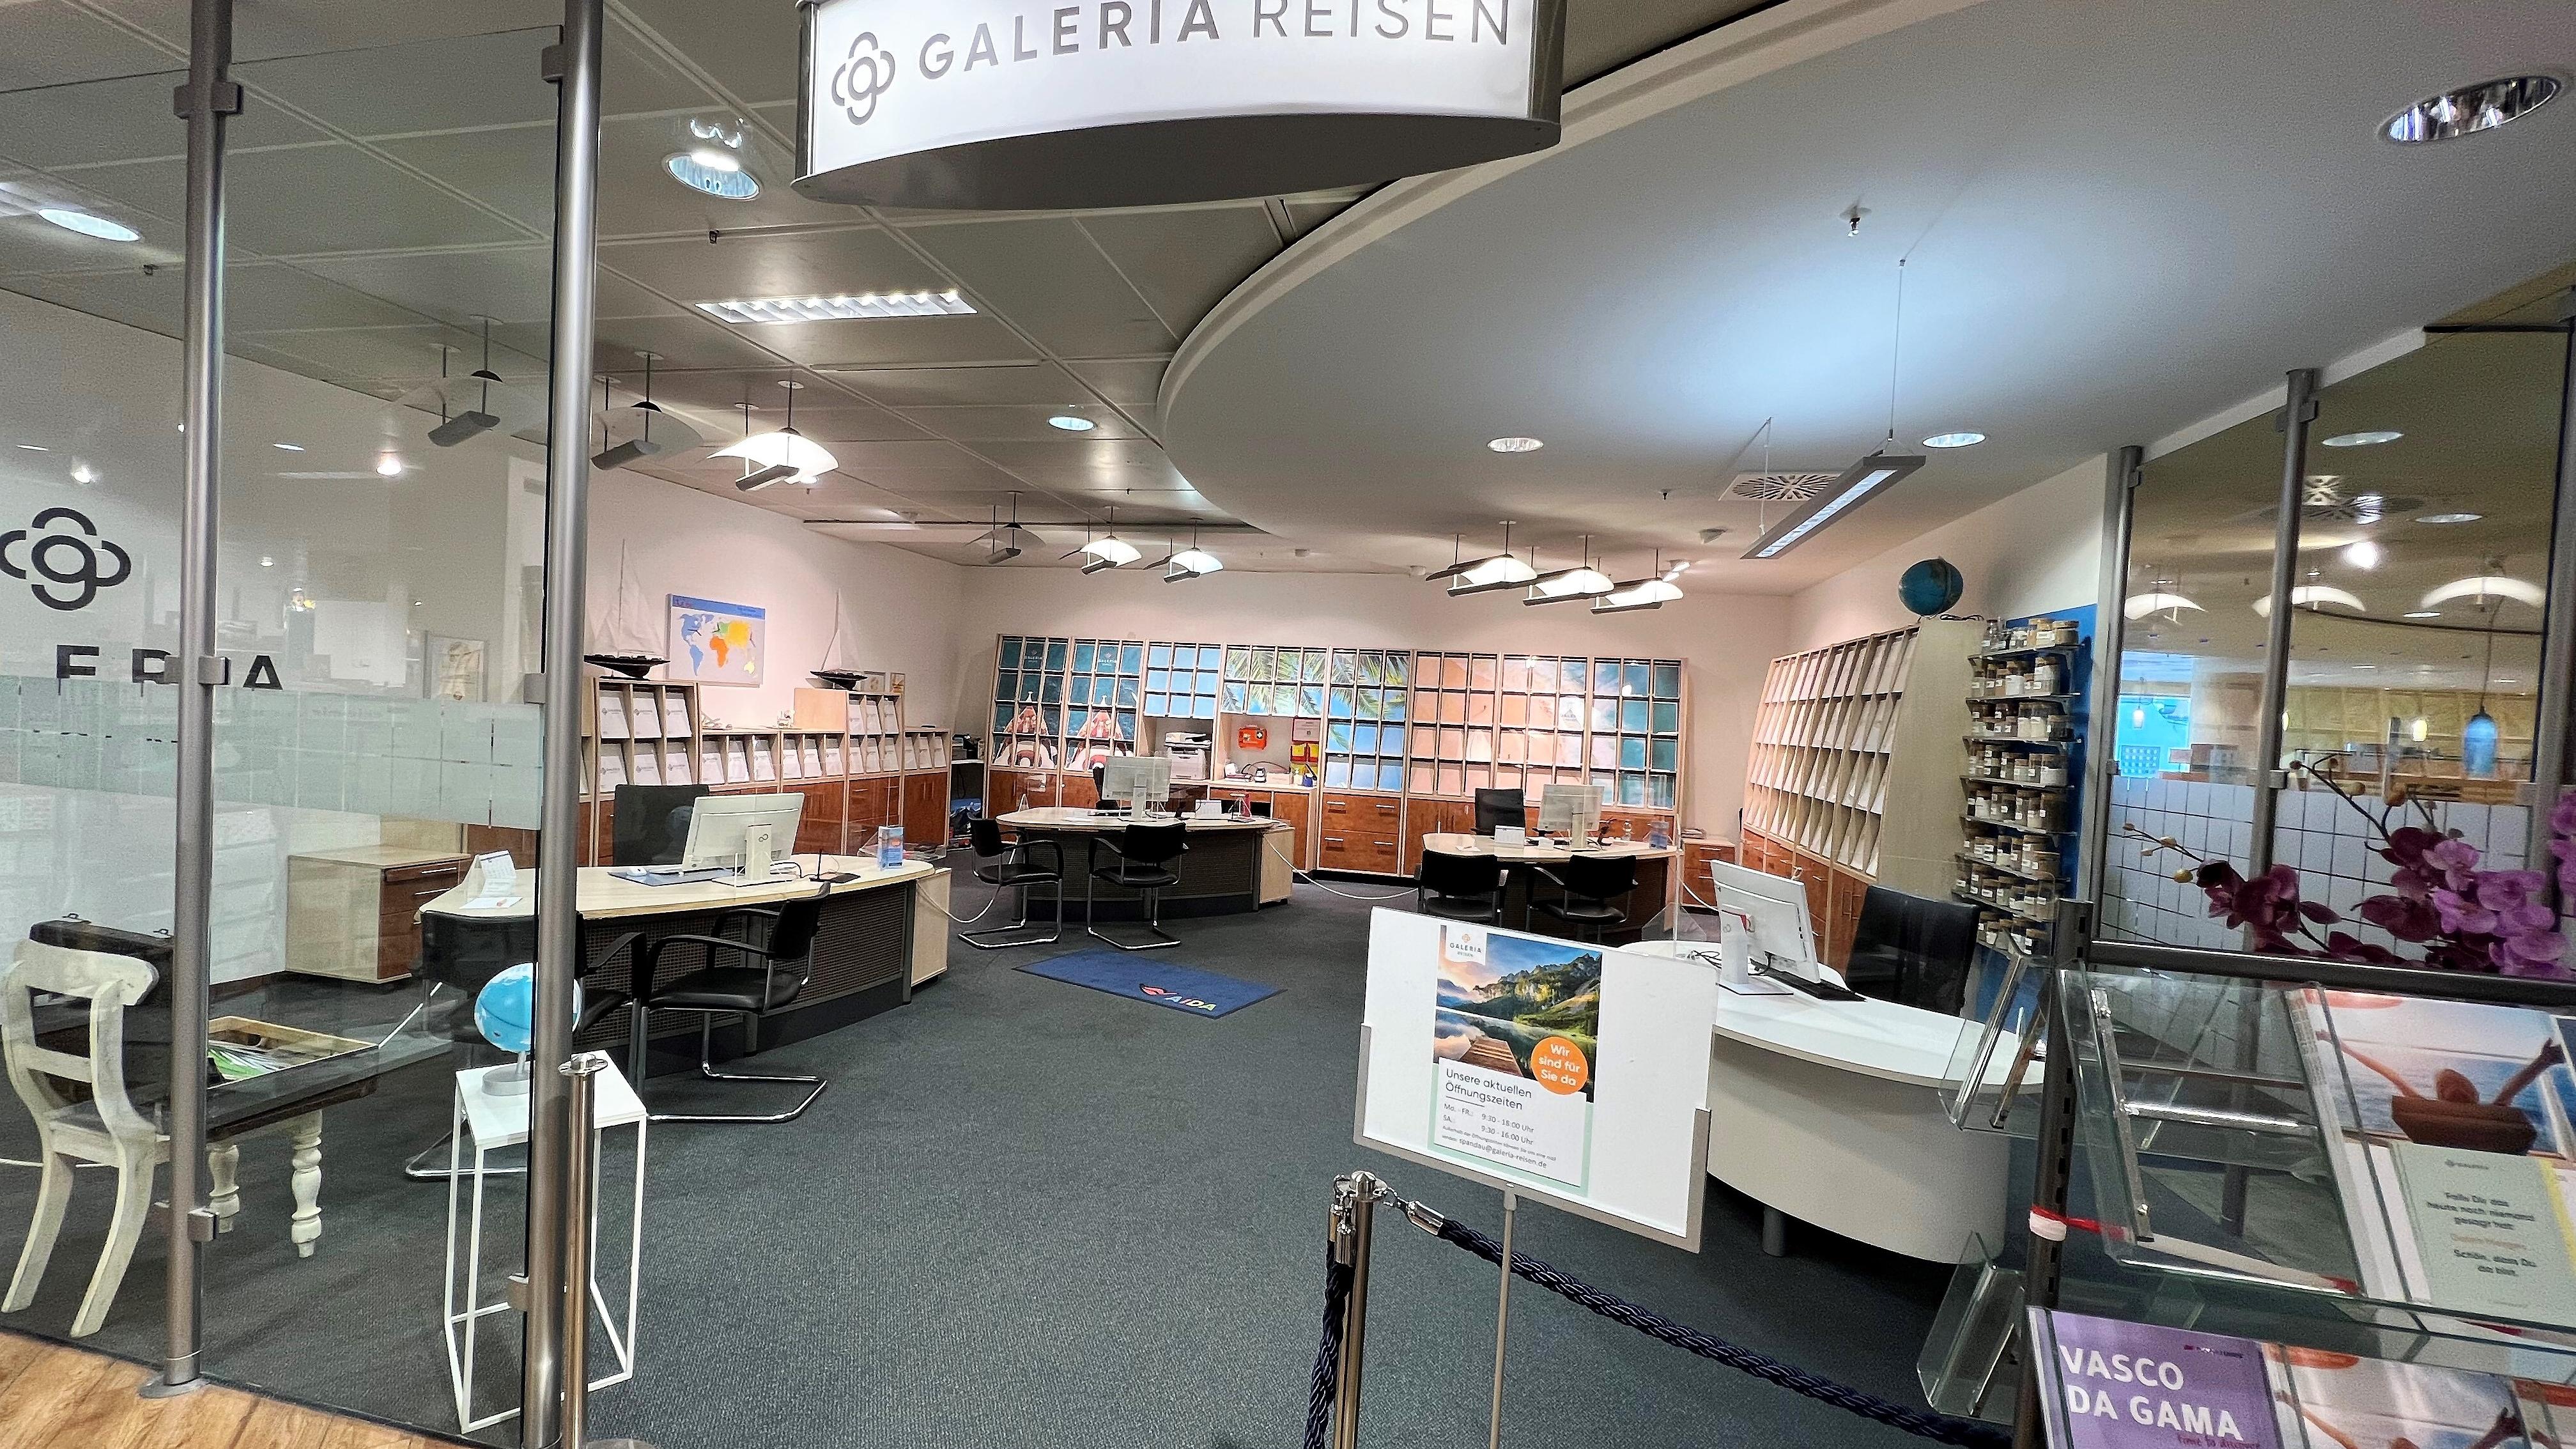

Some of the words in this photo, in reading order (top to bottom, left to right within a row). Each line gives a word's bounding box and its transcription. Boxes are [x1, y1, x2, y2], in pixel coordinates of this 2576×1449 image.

[919, 0, 1220, 79] GALERIA
[1253, 0, 1508, 45] REISEN
[1449, 942, 1482, 953] GALERIA
[1550, 1043, 1570, 1057] Wir
[1538, 1055, 1562, 1069] sind
[1564, 1060, 1581, 1073] für
[1446, 1068, 1481, 1085] Unsere
[1483, 1079, 1532, 1099] aktuellen
[1540, 1069, 1558, 1082] Sie
[1560, 1074, 1577, 1086] da
[1446, 1080, 1523, 1110] Öffnungszeiten
[1481, 1125, 1495, 1135] 9:30
[1521, 1136, 1534, 1145] Uhr
[1522, 1124, 1534, 1133] Uhr
[1459, 1138, 1547, 1168] spandau@galeria-reisen.de
[2059, 1345, 2184, 1391] VASCO
[2067, 1384, 2118, 1420] DA
[2129, 1395, 2244, 1441] GAMA
